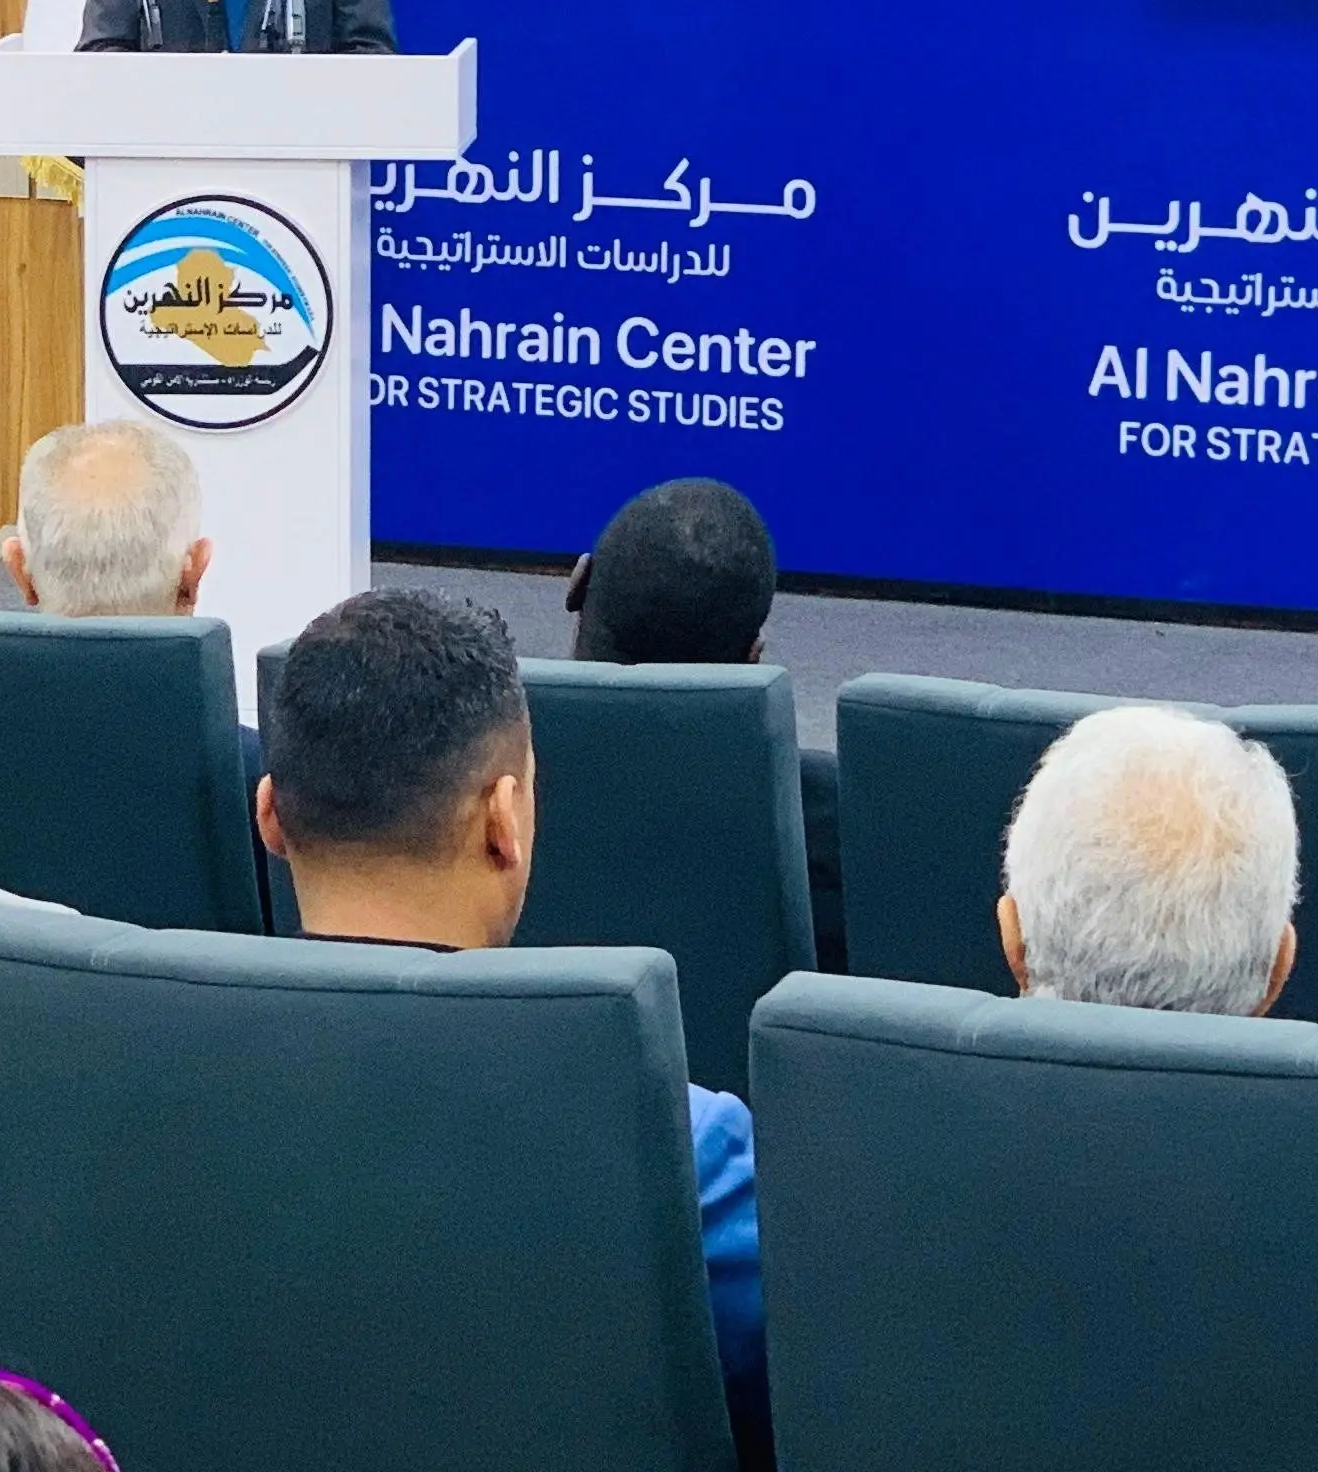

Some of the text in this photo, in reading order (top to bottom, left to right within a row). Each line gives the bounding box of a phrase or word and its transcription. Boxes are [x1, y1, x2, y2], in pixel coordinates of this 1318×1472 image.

[370, 154, 816, 228] مركز النهري
[376, 227, 730, 284] للدراسات الاستراتيجية
[124, 276, 210, 316] النهرين
[217, 282, 294, 314] مركز
[381, 303, 817, 378] Nahrain Center
[1088, 345, 1148, 399] Al
[370, 373, 784, 431] OR STRATEGIC STUDIES
[1119, 421, 1197, 458] FOR
